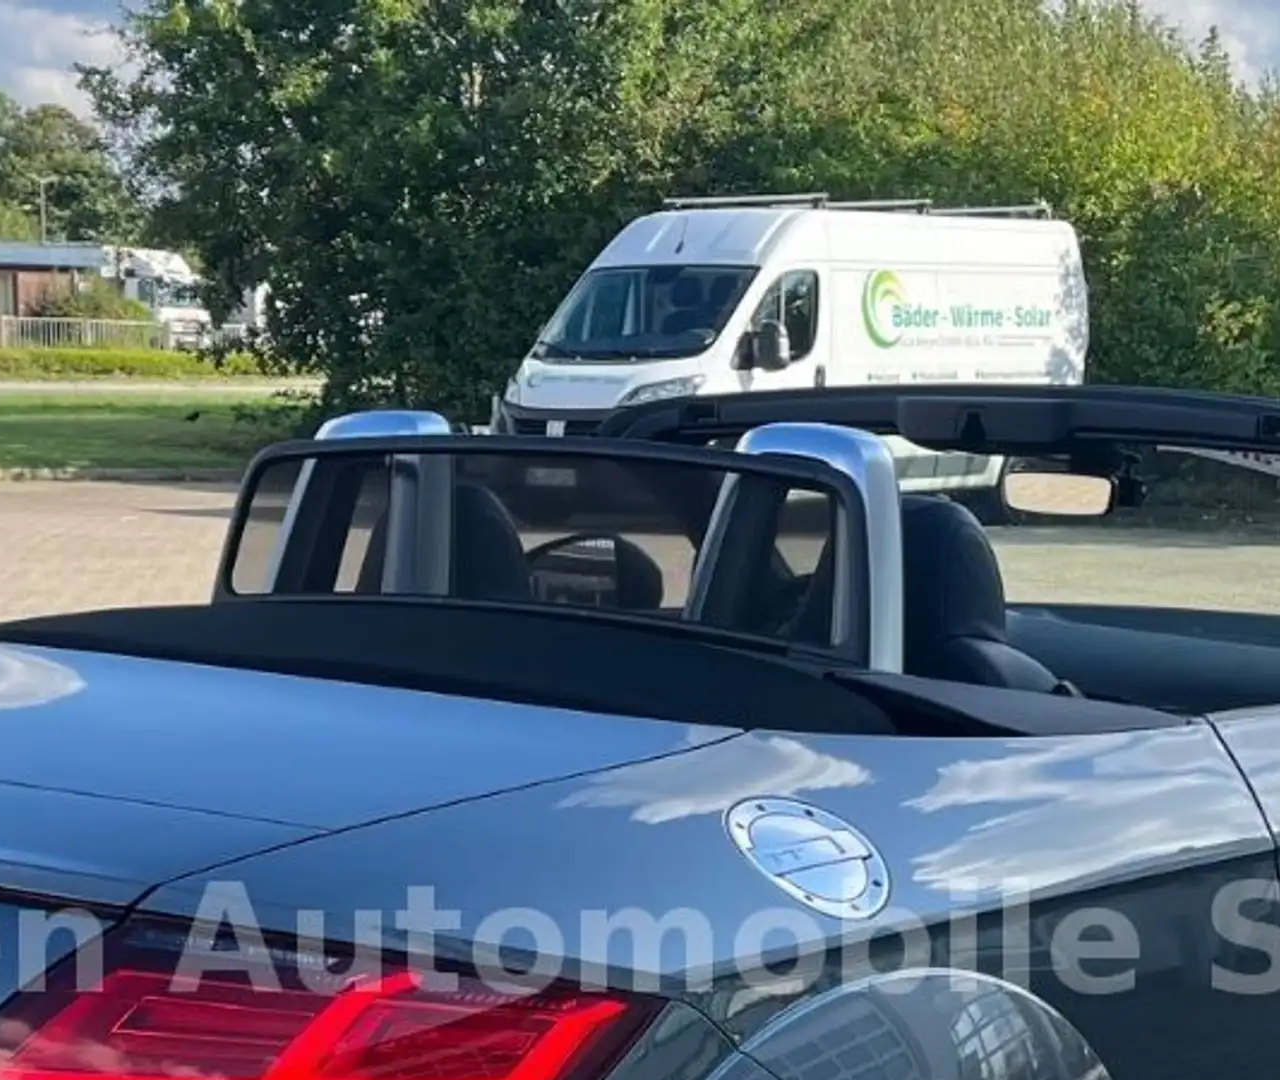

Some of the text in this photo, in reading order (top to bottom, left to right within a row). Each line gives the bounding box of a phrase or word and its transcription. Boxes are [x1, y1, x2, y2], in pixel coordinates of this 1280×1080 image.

[891, 304, 939, 328] Bäder
[950, 305, 1003, 328] Wärme
[1014, 306, 1052, 328] Solar
